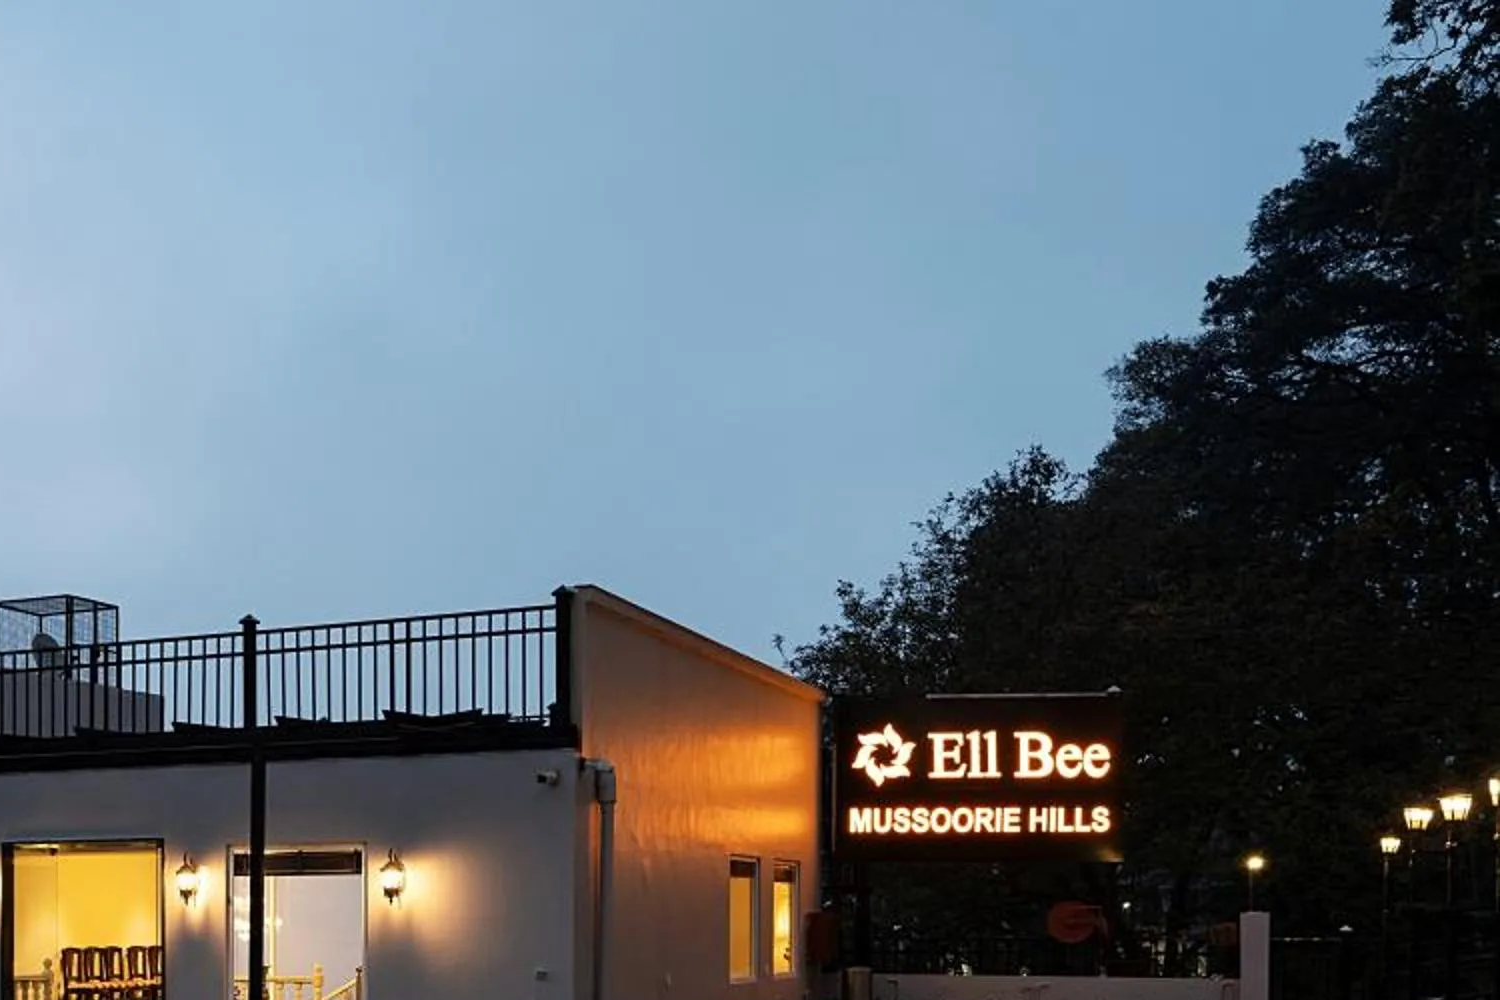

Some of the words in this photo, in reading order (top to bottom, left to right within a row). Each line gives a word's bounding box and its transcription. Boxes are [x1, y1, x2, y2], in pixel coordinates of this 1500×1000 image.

[927, 729, 1002, 779] Ell
[1013, 730, 1111, 779] Bee
[849, 807, 1021, 833] MUSSOORIE
[1028, 806, 1111, 833] HILLS
